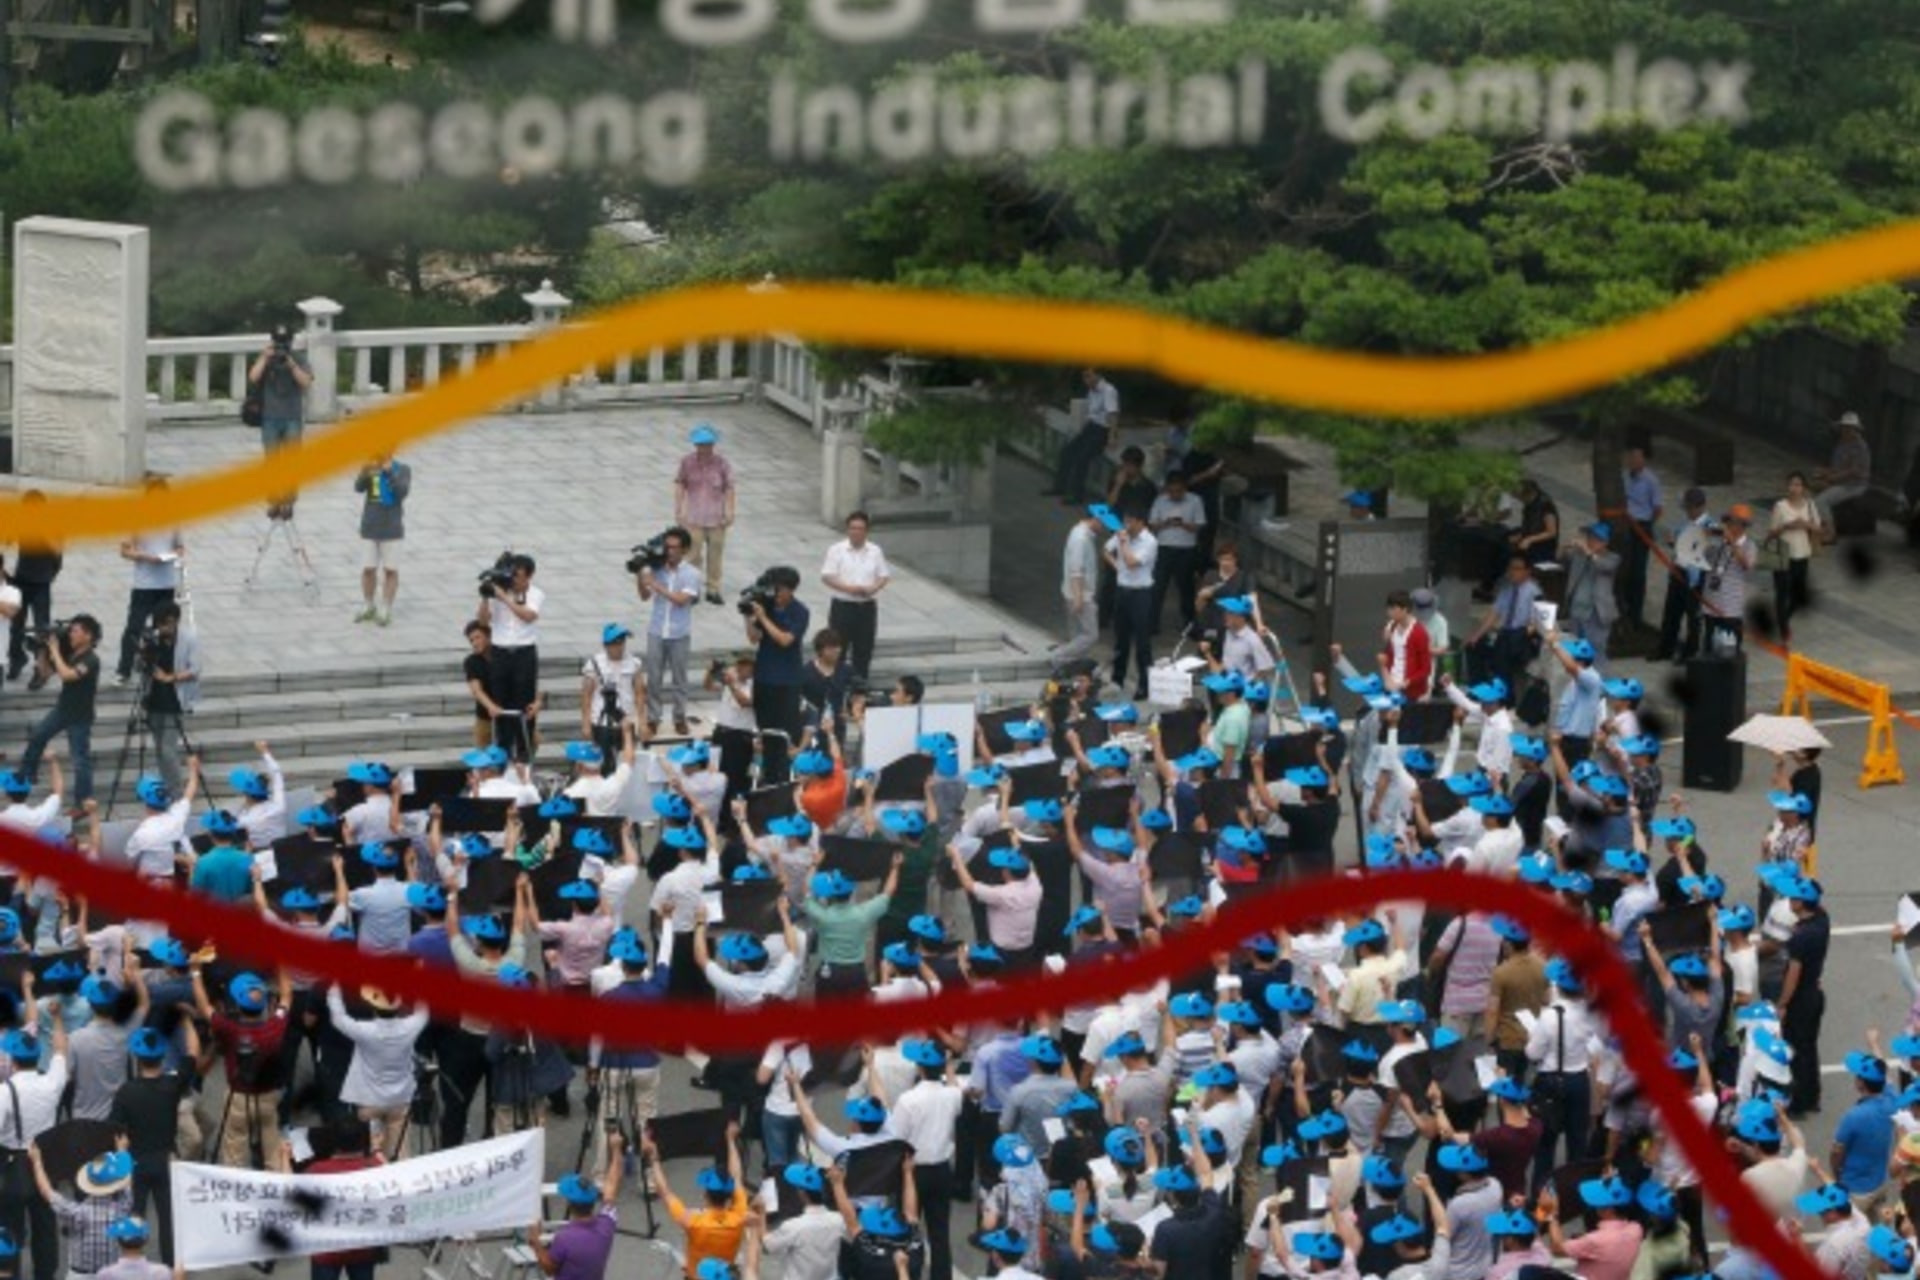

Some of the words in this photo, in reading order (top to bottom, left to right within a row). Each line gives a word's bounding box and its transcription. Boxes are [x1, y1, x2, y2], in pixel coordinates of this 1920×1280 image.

[135, 91, 706, 190] Gaeseong
[768, 56, 1266, 164] Industrial
[1319, 44, 1753, 143] Complex
